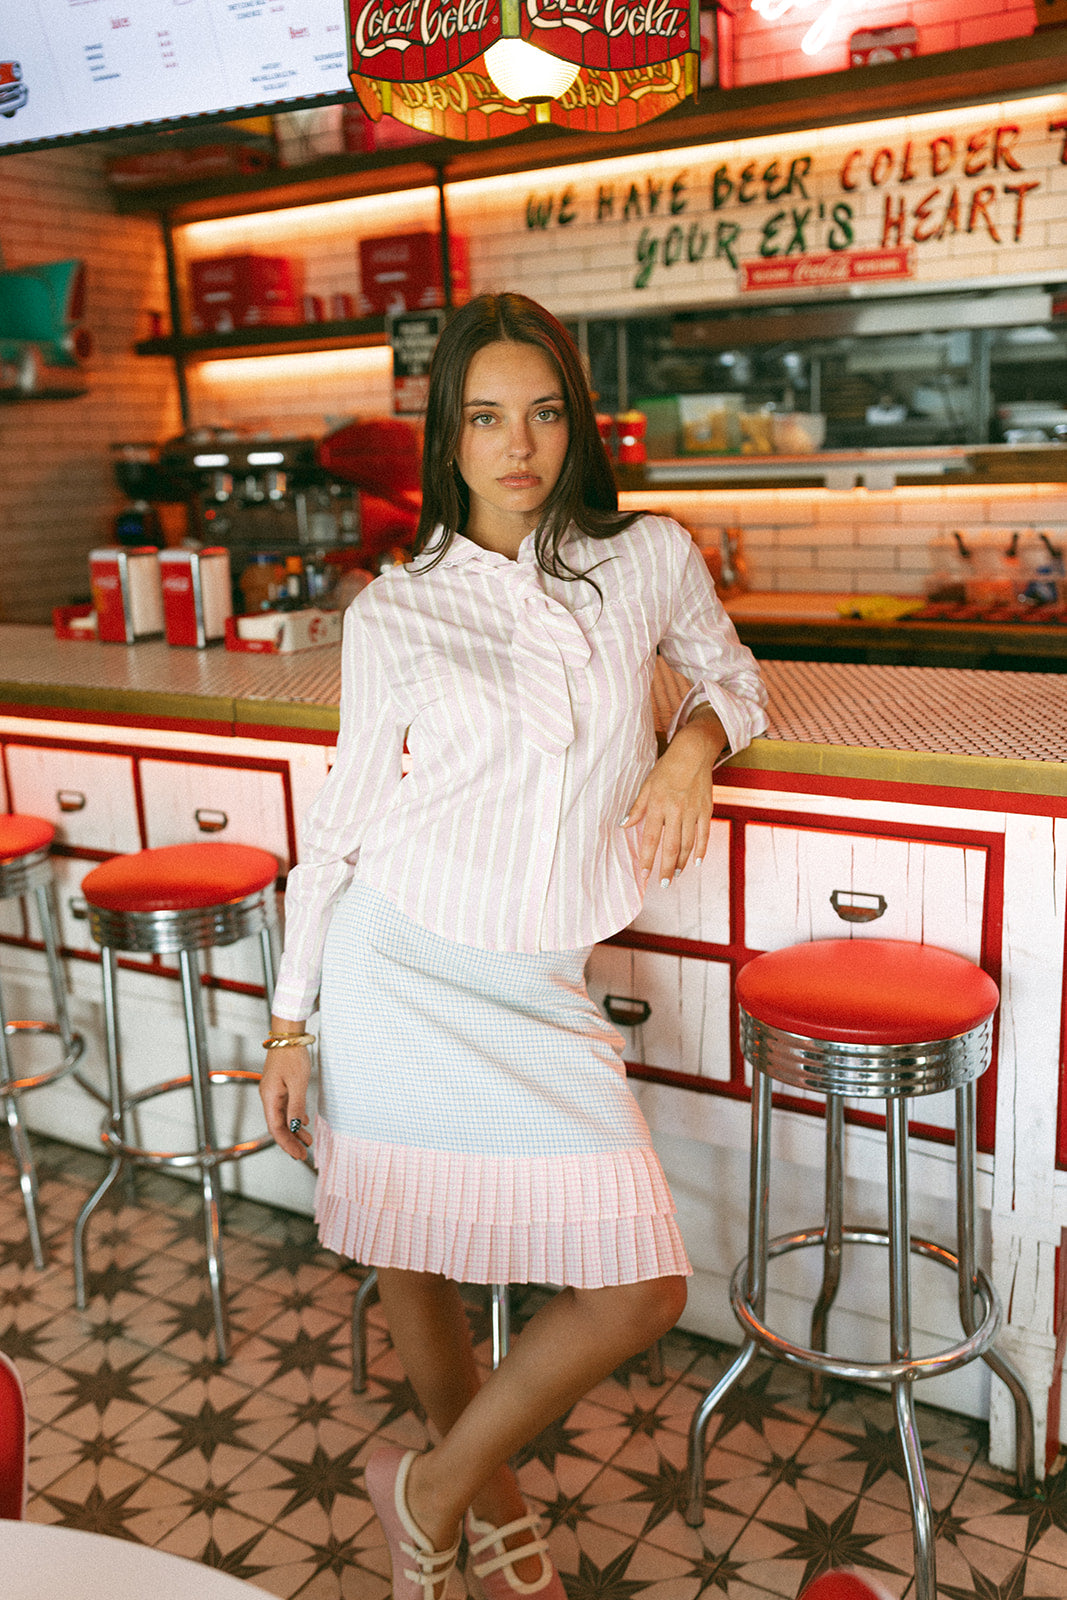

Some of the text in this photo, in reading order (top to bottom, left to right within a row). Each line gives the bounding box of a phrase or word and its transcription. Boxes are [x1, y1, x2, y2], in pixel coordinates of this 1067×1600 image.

[525, 183, 577, 230] WE
[596, 168, 689, 222] HAVE
[712, 156, 812, 210] BEER
[840, 125, 1024, 191] COLDER
[633, 181, 1041, 289] YOUR EX'S HEART
